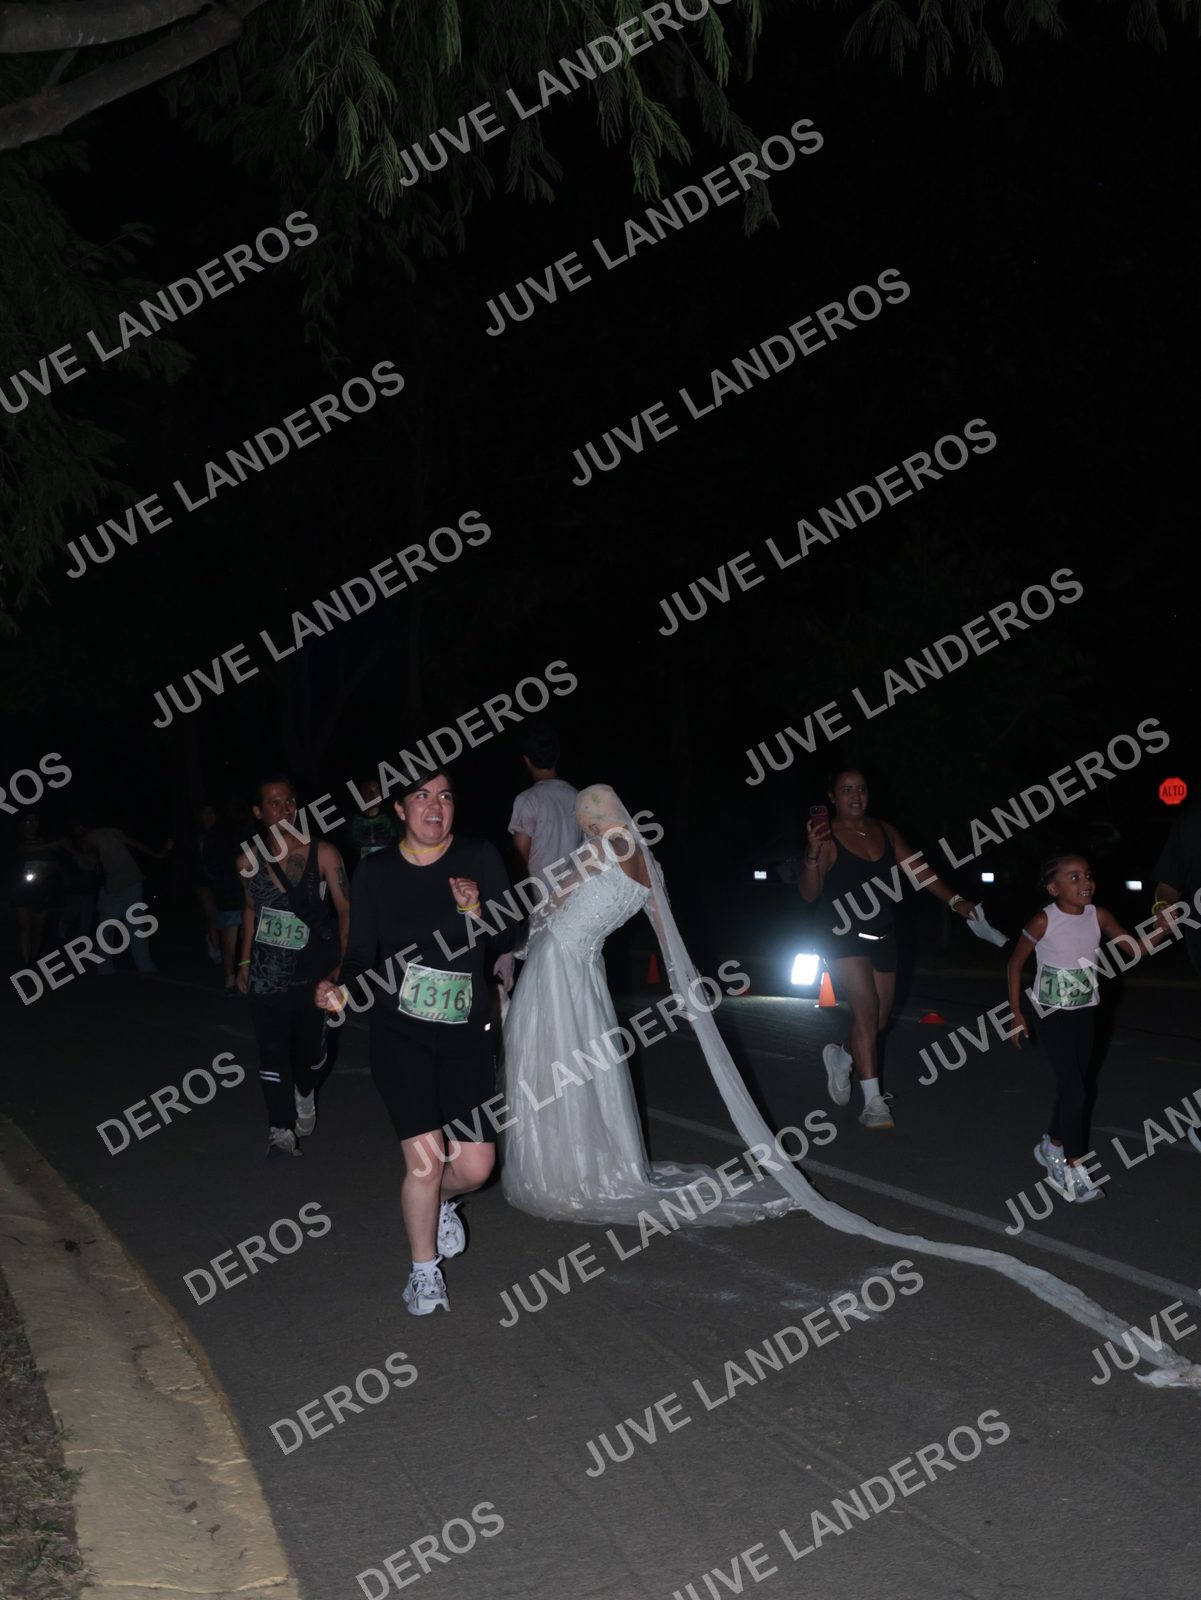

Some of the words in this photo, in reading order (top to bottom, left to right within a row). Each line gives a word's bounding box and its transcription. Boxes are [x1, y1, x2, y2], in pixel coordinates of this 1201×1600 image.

[1161, 784, 1185, 798] ALTO
[265, 920, 305, 940] 1315
[411, 983, 466, 1012] 1316
